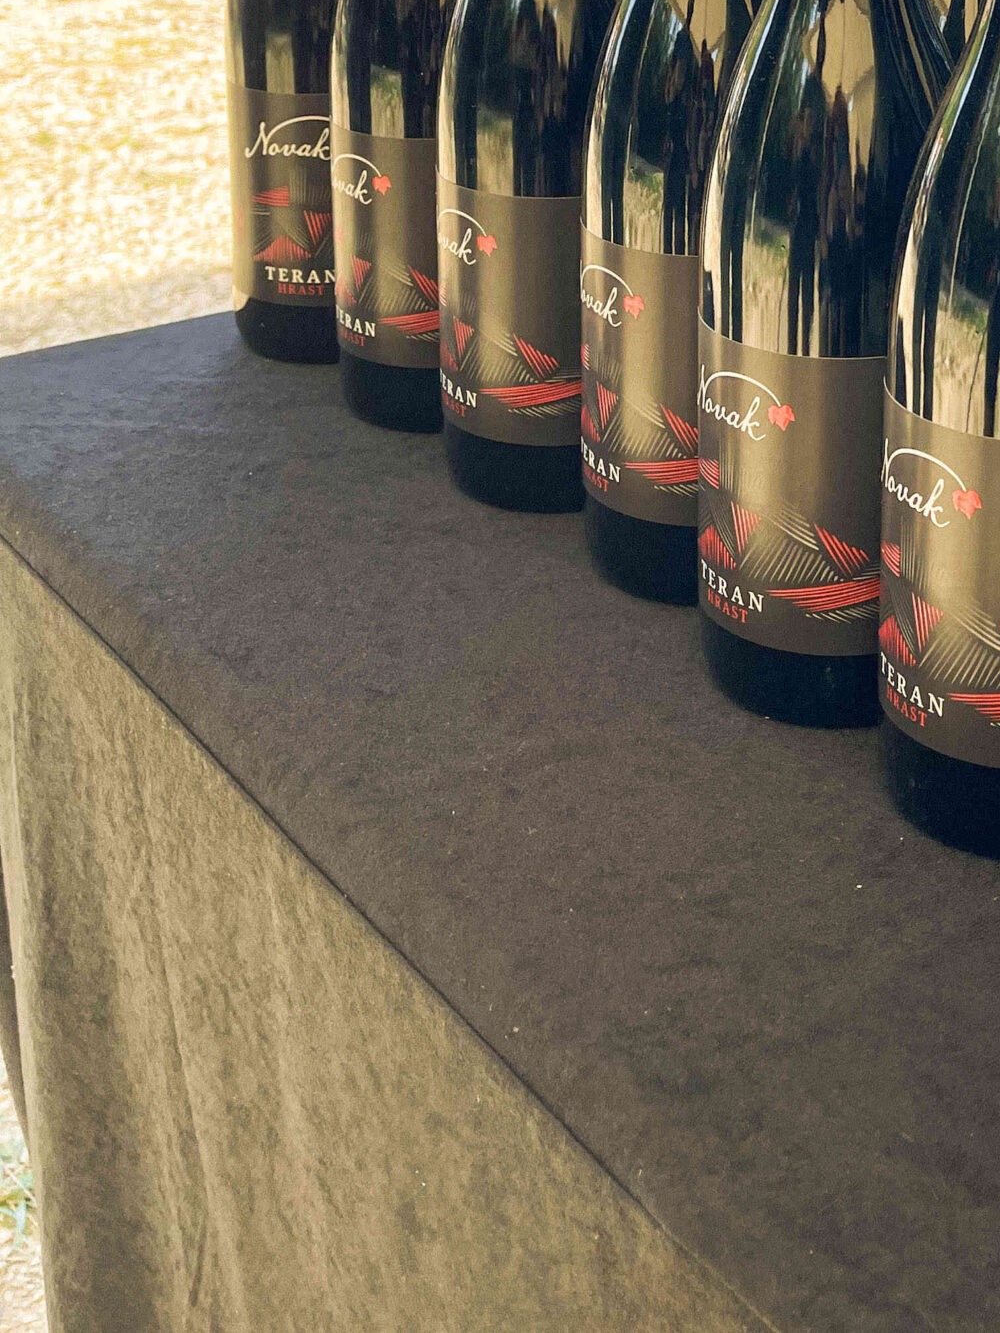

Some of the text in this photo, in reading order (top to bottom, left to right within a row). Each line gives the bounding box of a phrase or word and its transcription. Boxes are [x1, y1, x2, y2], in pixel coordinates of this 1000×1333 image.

[245, 115, 331, 161] Novak
[265, 265, 335, 284] TERAN
[277, 283, 324, 296] HRAST
[697, 364, 767, 441] Novak
[881, 437, 950, 528] Novak
[701, 558, 765, 613] TERAN
[707, 587, 749, 623] HRAST
[881, 651, 945, 718] TERAN
[886, 686, 928, 727] HRAST
